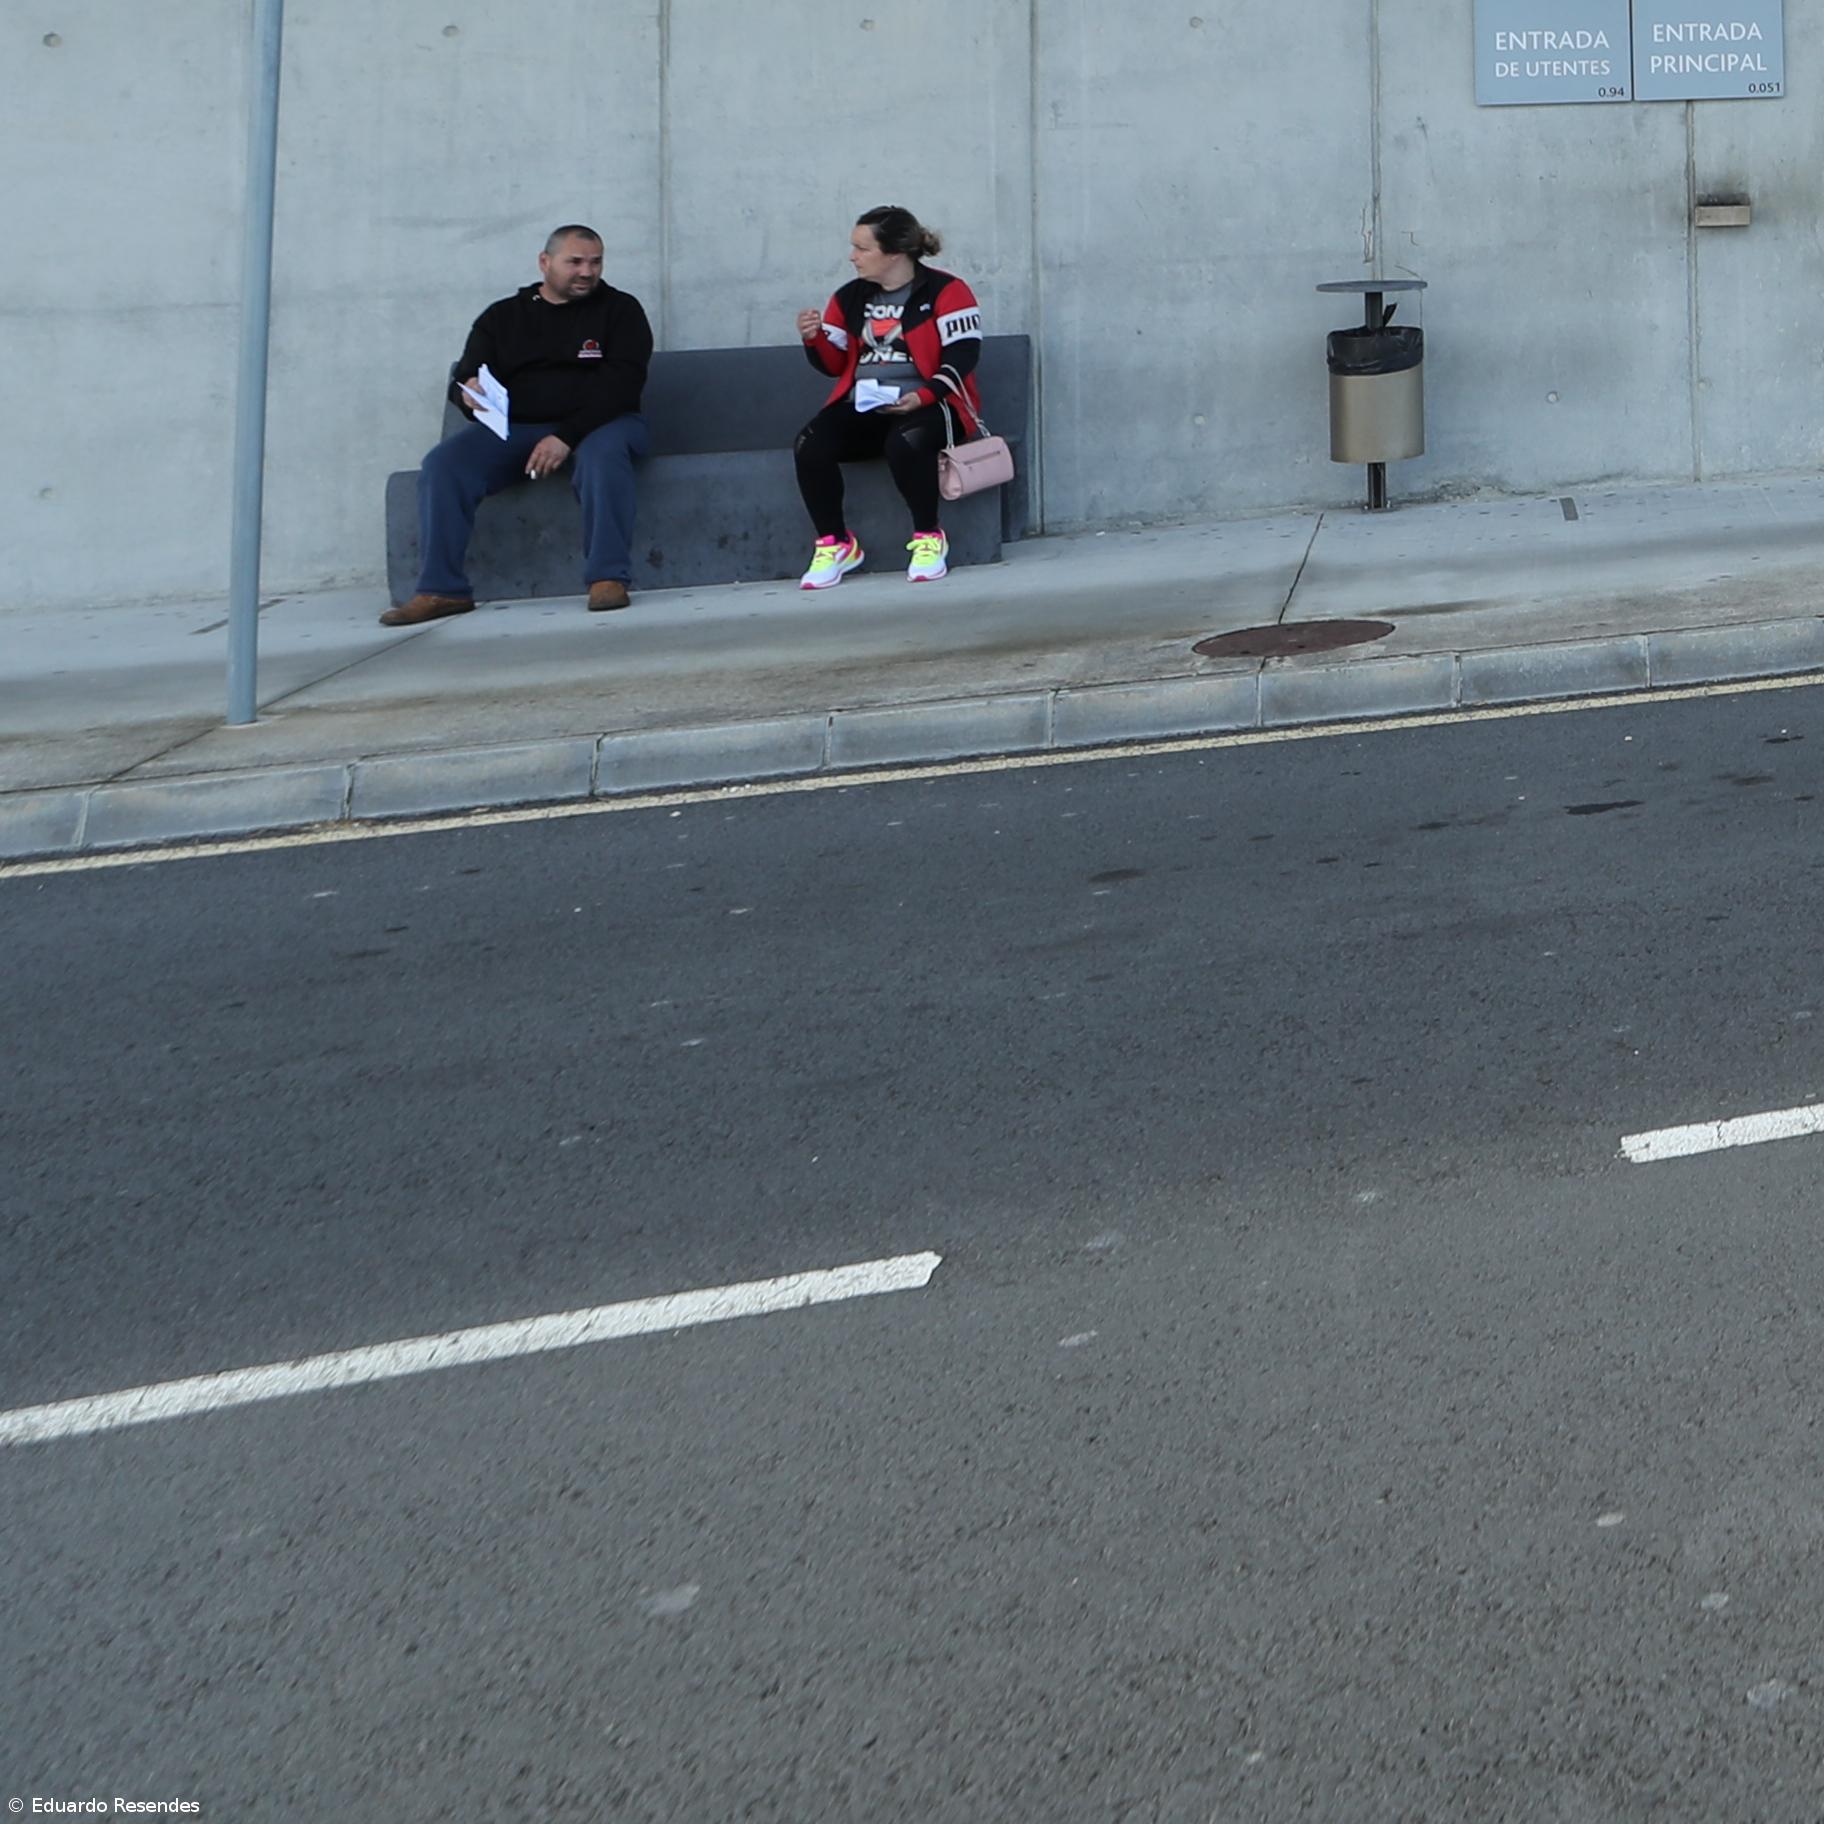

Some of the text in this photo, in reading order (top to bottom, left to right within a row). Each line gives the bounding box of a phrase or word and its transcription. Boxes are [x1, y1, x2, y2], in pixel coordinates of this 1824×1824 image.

[1496, 30, 1610, 51] ENTRADA
[1653, 22, 1763, 42] ENTRADA
[1496, 60, 1611, 78] DE UTENTES
[1650, 53, 1767, 73] PRINCIPAL
[1598, 87, 1625, 98] 0.94
[1748, 82, 1781, 94] 0.051
